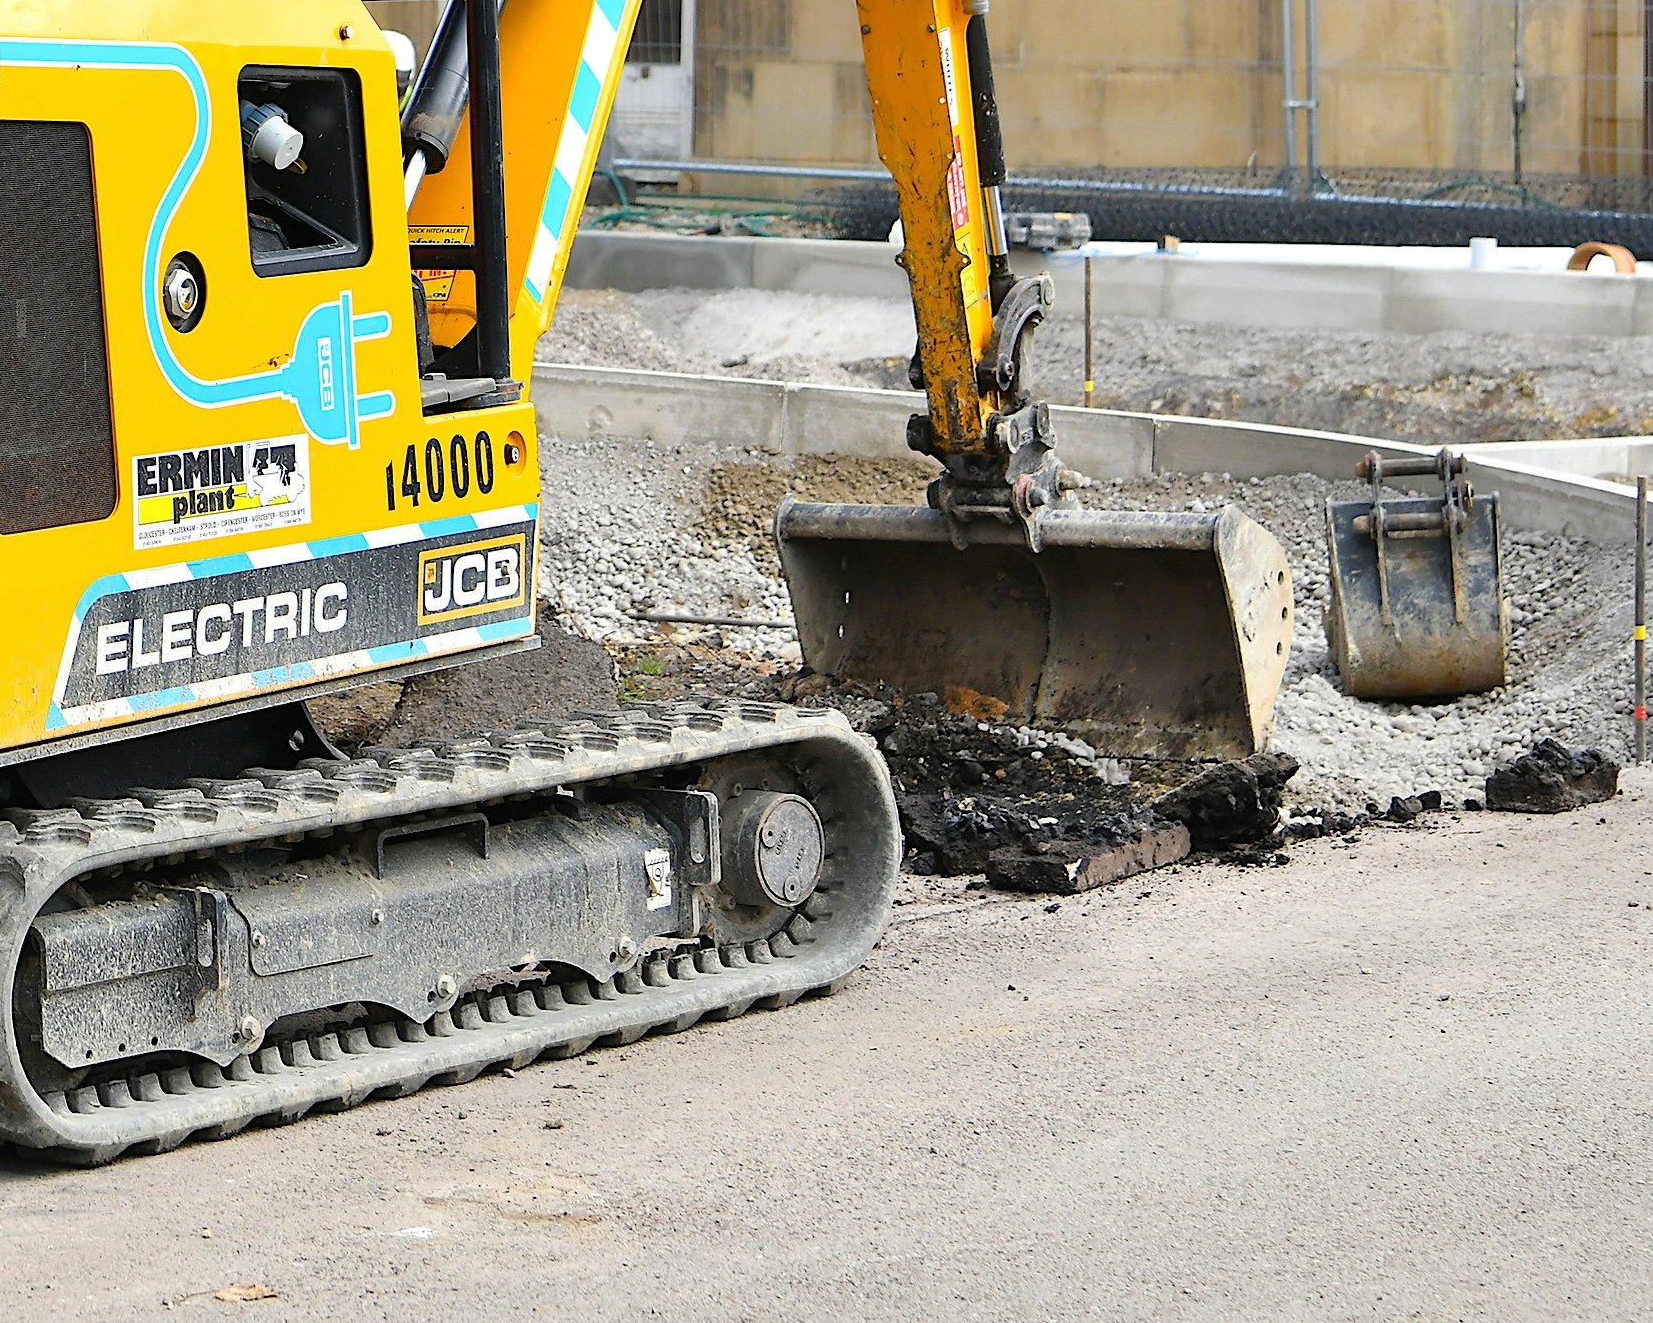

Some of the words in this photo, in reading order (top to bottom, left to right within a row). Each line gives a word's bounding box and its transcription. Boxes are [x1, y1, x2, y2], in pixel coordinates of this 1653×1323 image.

[320, 344, 332, 408] JCB
[137, 445, 245, 496] ERMIN
[385, 430, 494, 511] 14000
[173, 485, 235, 524] plant
[424, 547, 520, 612] JCB
[95, 582, 349, 675] ELECTRIC
